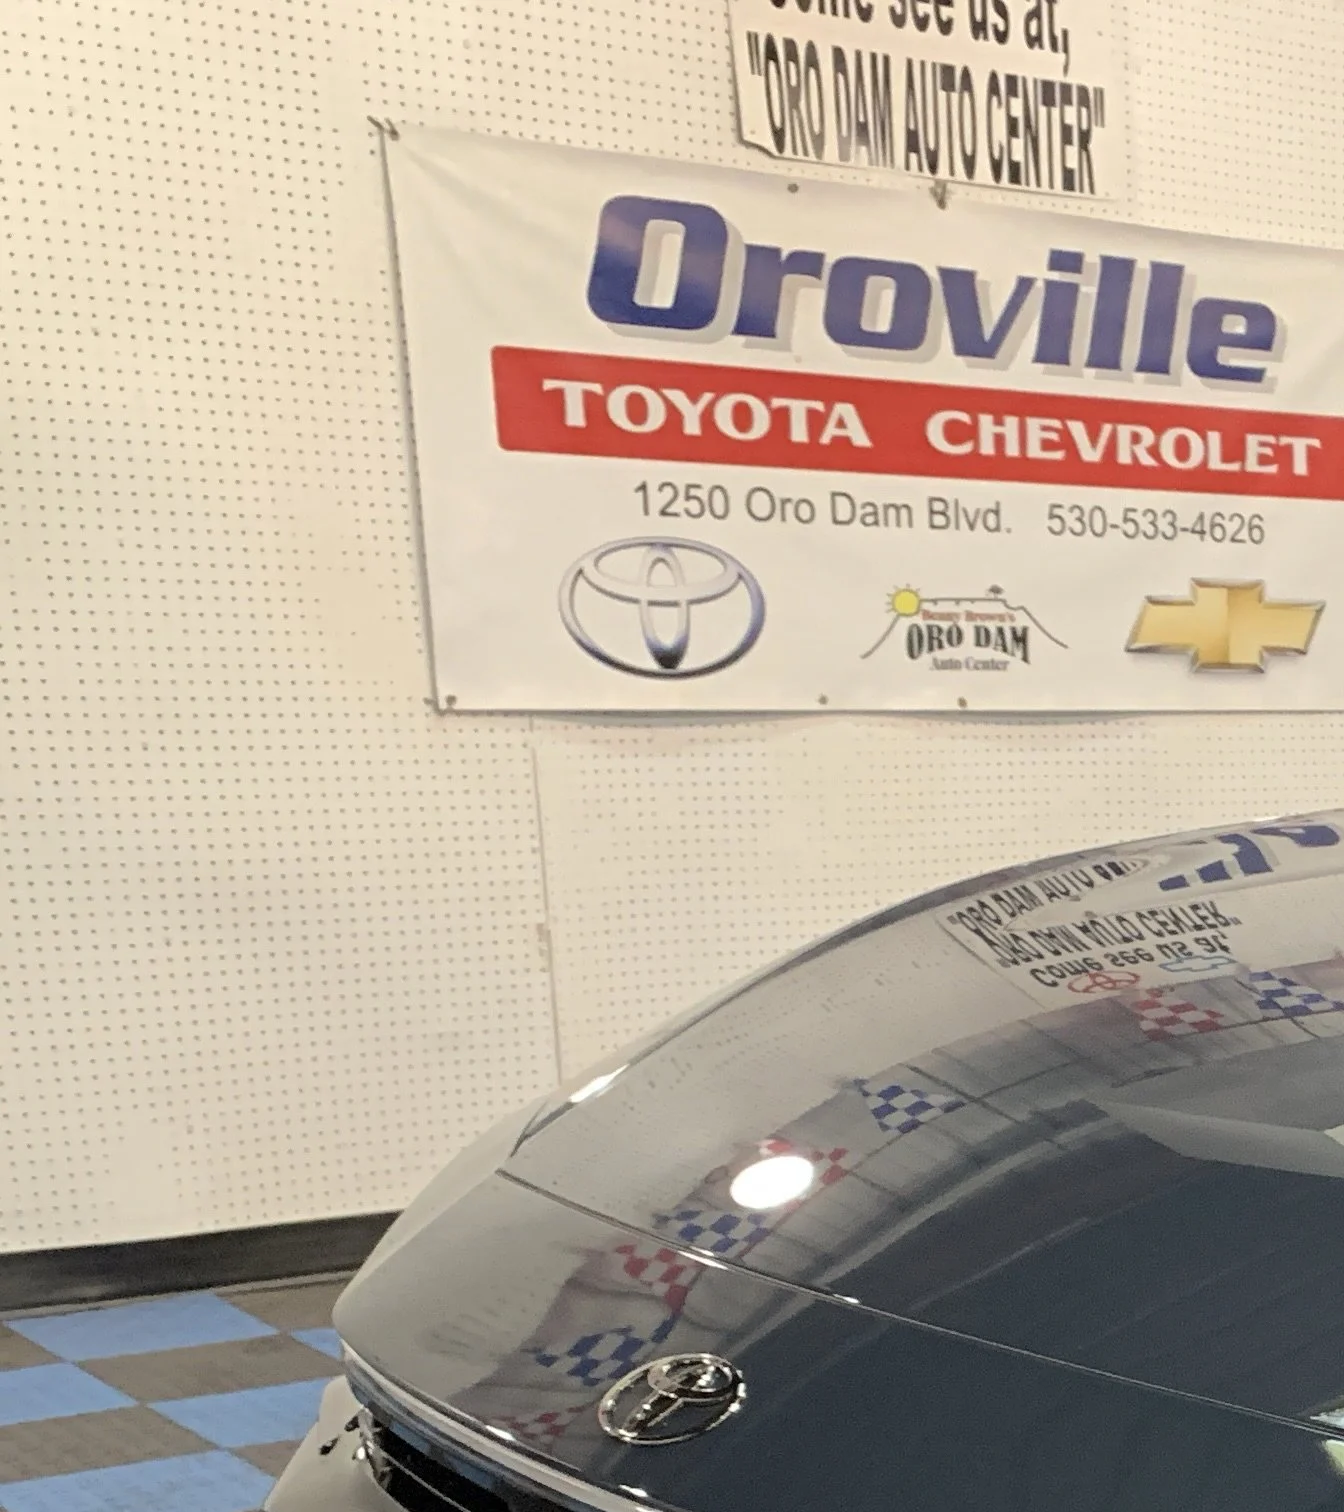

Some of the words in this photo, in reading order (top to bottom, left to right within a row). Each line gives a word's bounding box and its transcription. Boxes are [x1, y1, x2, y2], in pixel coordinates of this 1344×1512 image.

[832, 45, 895, 169] DAM
[905, 57, 978, 181] AUTO
[586, 194, 1277, 383] Oroville
[542, 378, 873, 448] TOYOTA
[925, 410, 1321, 477] CHEVROLET
[634, 480, 730, 520] 1250
[745, 486, 816, 525] Oro
[830, 491, 914, 528] Dam
[927, 497, 1013, 534] Blvd.
[1046, 503, 1266, 545] 530-533-4626
[906, 622, 964, 660] ORO
[973, 624, 1031, 665] DAM
[929, 656, 962, 671] Auto
[964, 656, 1010, 671] Center
